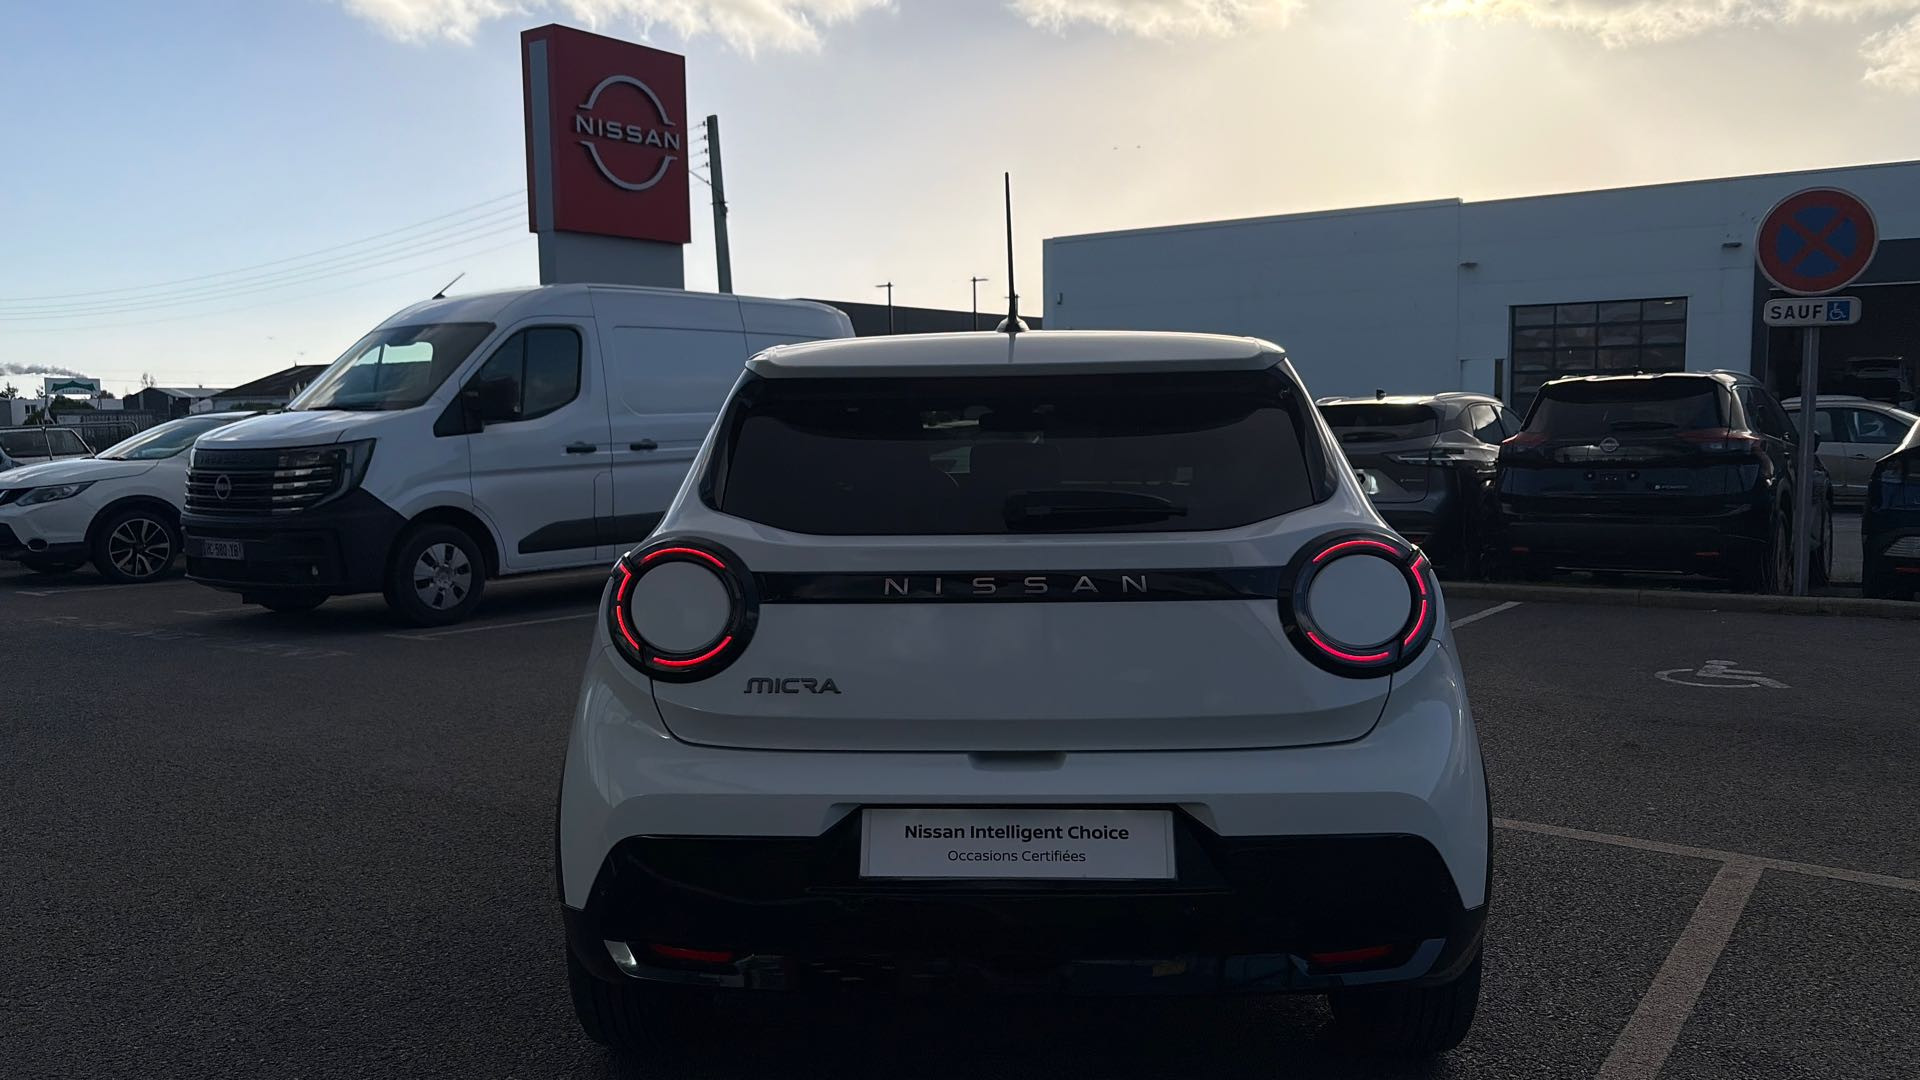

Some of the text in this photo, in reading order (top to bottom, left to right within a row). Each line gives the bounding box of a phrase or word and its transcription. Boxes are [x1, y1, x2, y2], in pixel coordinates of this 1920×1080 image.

[575, 113, 680, 150] NISSAN
[1770, 304, 1823, 319] SAUF
[884, 575, 1148, 596] NISSAN
[743, 677, 842, 694] MICRA
[904, 824, 1130, 842] Nissan Intelligent Choice
[948, 849, 1086, 862] Occasions Certifiées
